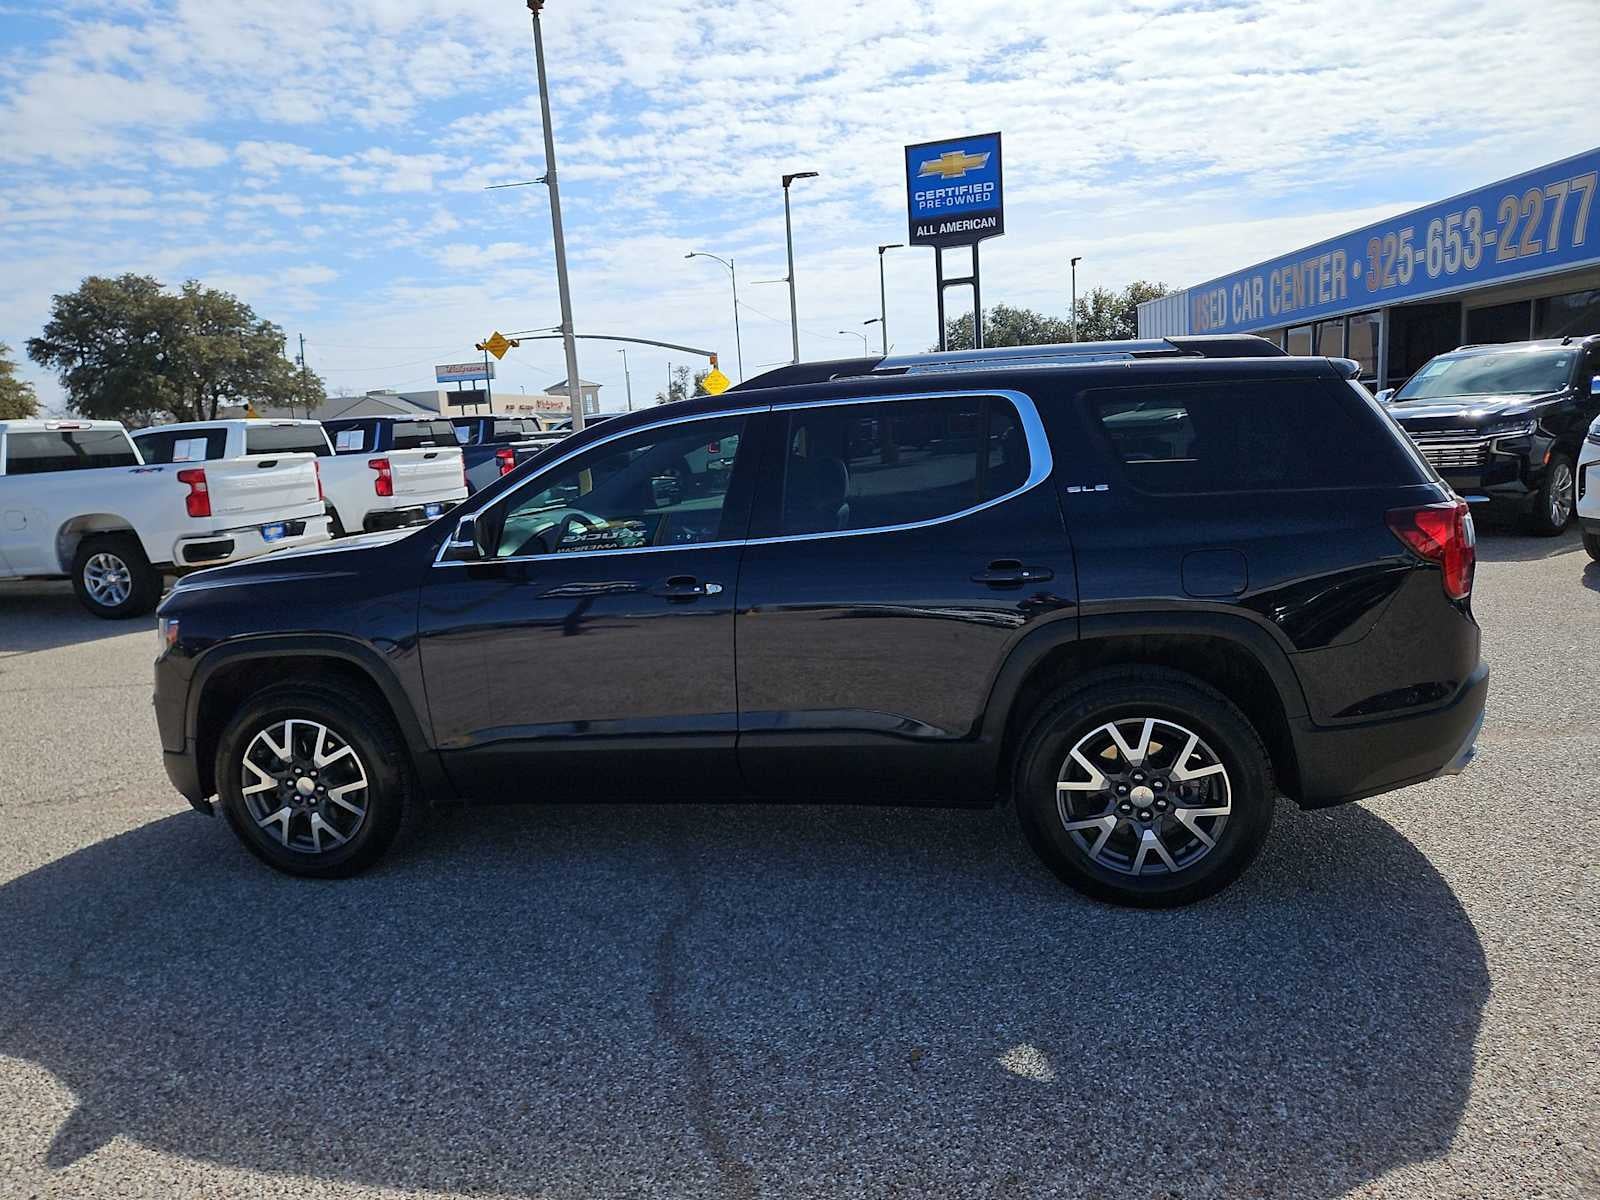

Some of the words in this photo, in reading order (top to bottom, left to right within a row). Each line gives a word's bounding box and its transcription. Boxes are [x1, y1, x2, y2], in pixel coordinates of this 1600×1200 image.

[915, 182, 994, 201] CERTIFIED
[919, 192, 991, 210] PRE-OWNED
[916, 224, 937, 237] ALL
[939, 217, 996, 234] AMERICAN
[1192, 286, 1228, 333] USED
[1231, 275, 1265, 324] CAR
[1269, 248, 1349, 316] CENTER
[1366, 170, 1599, 293] 325-653-2277
